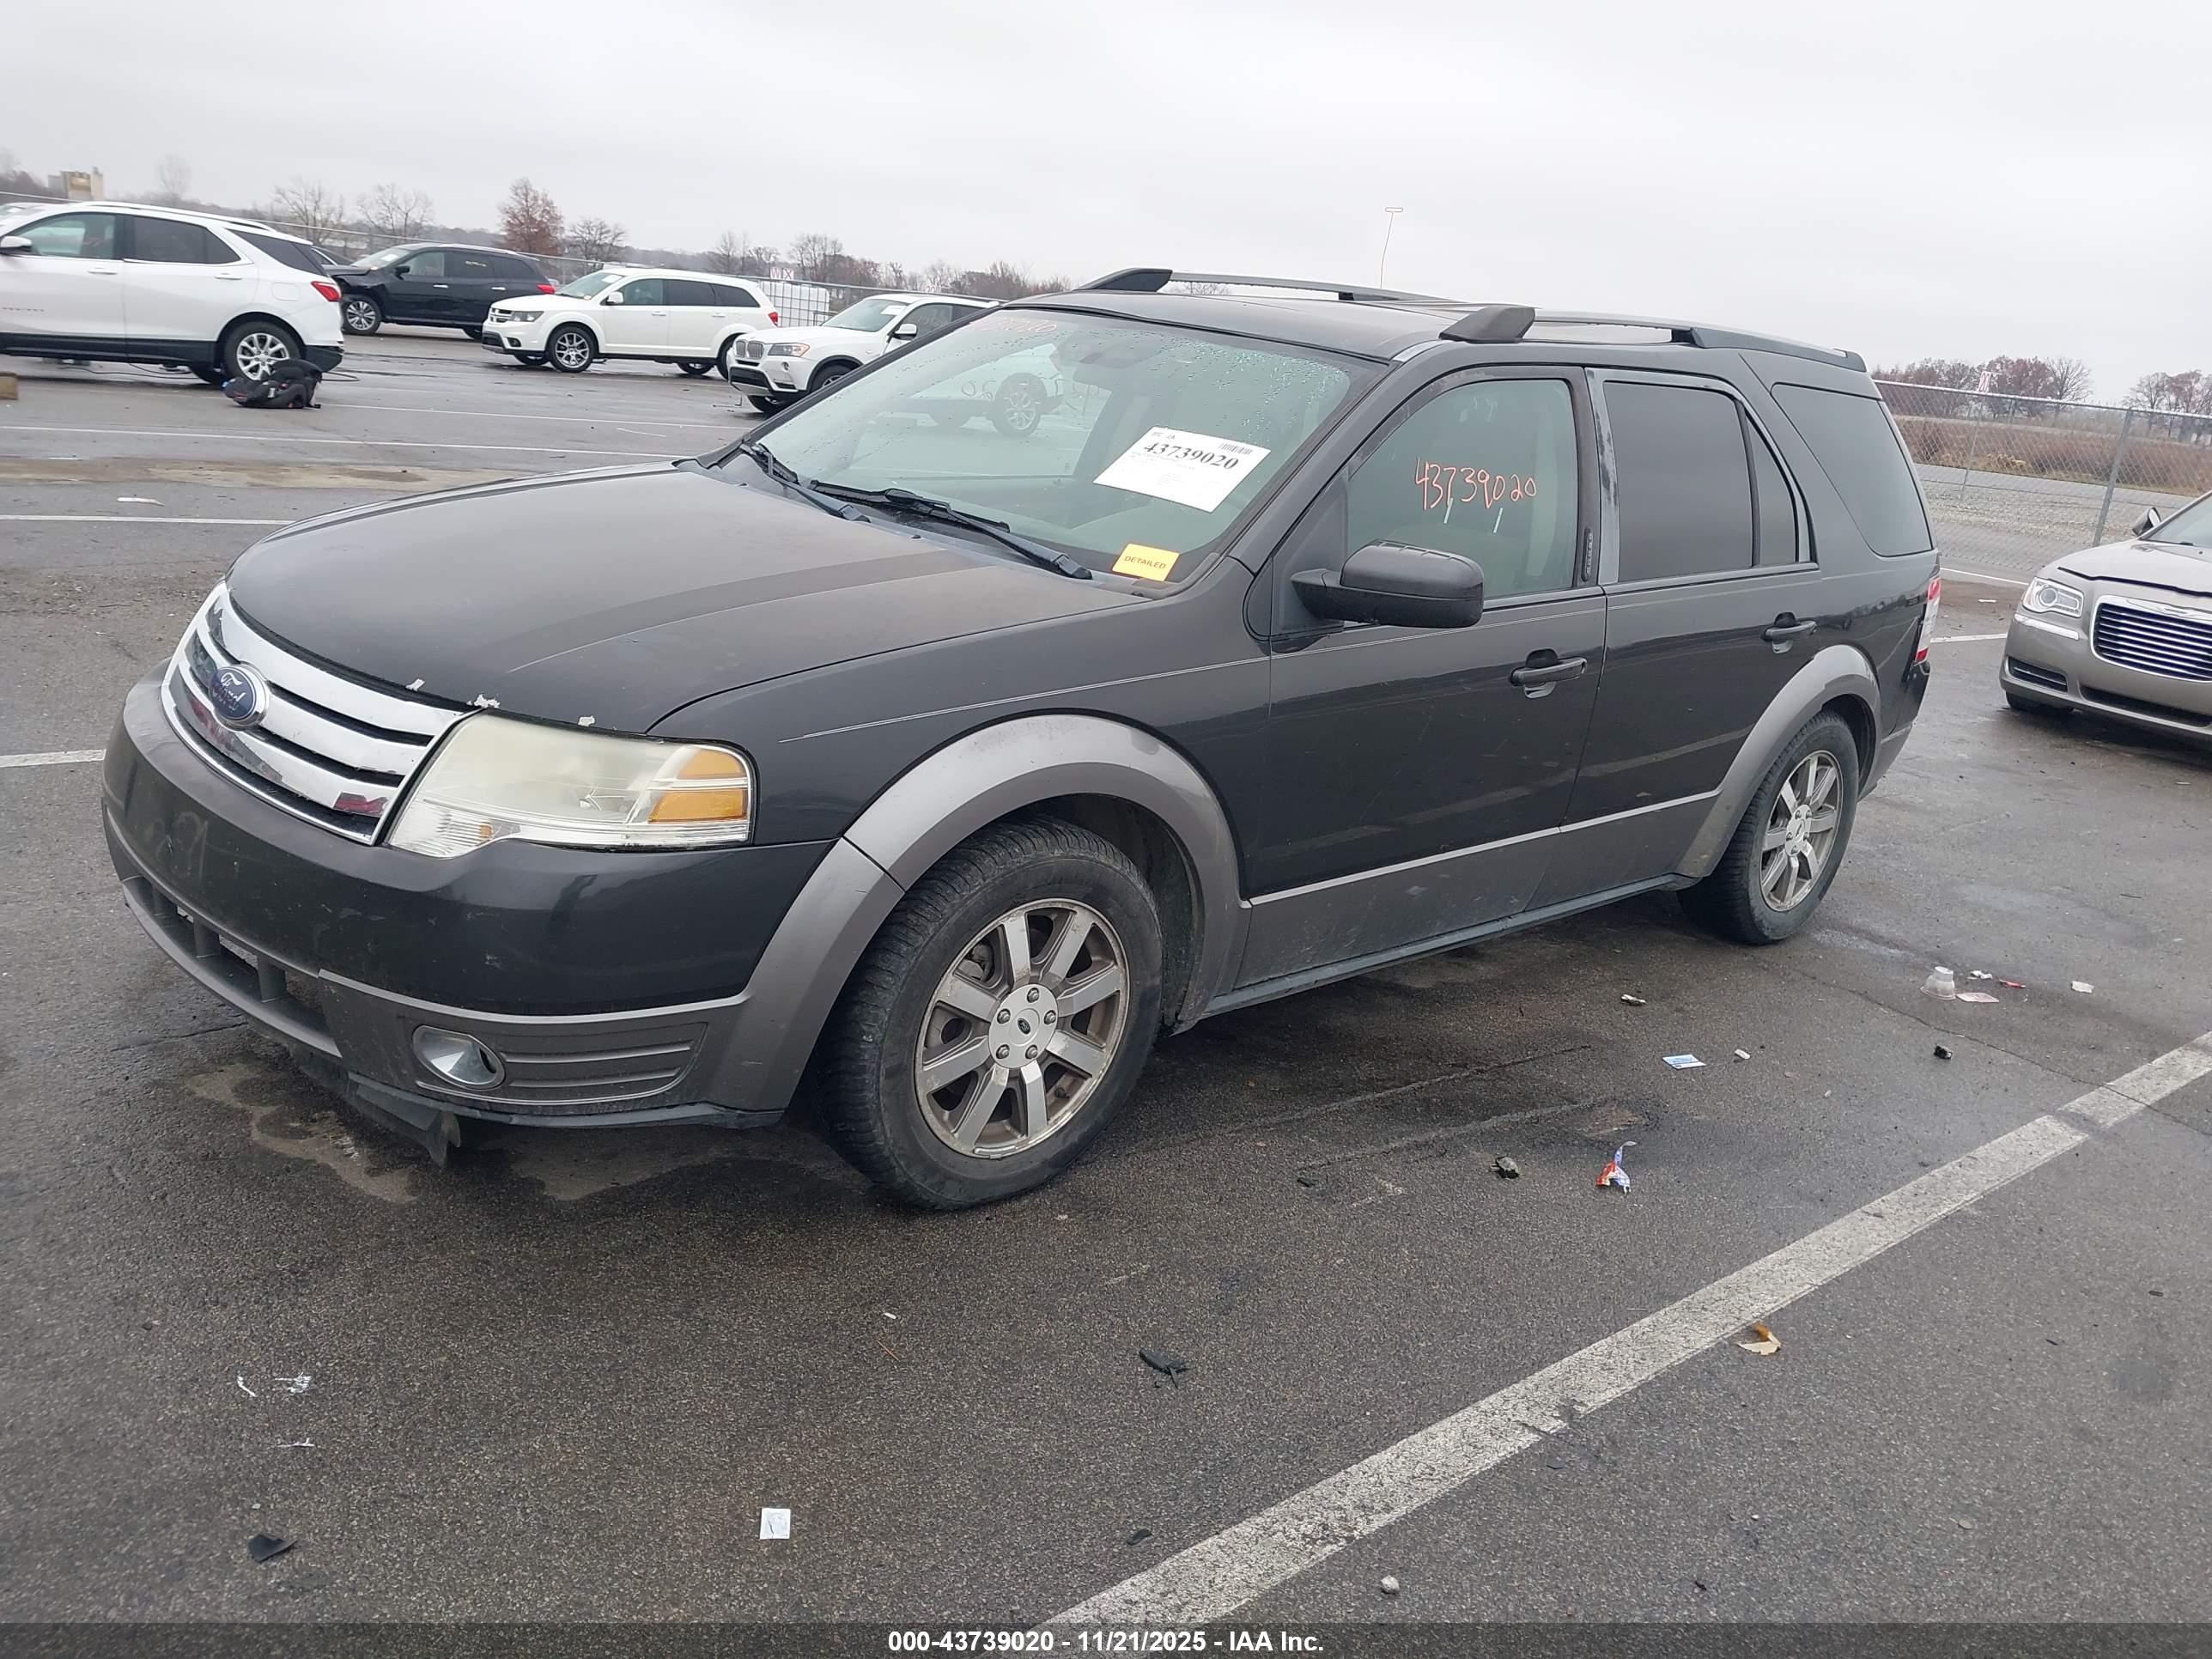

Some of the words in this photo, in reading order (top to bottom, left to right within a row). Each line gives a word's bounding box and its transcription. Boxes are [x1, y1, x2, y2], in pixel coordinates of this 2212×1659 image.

[1144, 441, 1239, 470] 43739020
[1415, 455, 1537, 510] 43739020
[1124, 556, 1167, 569] DETAILED
